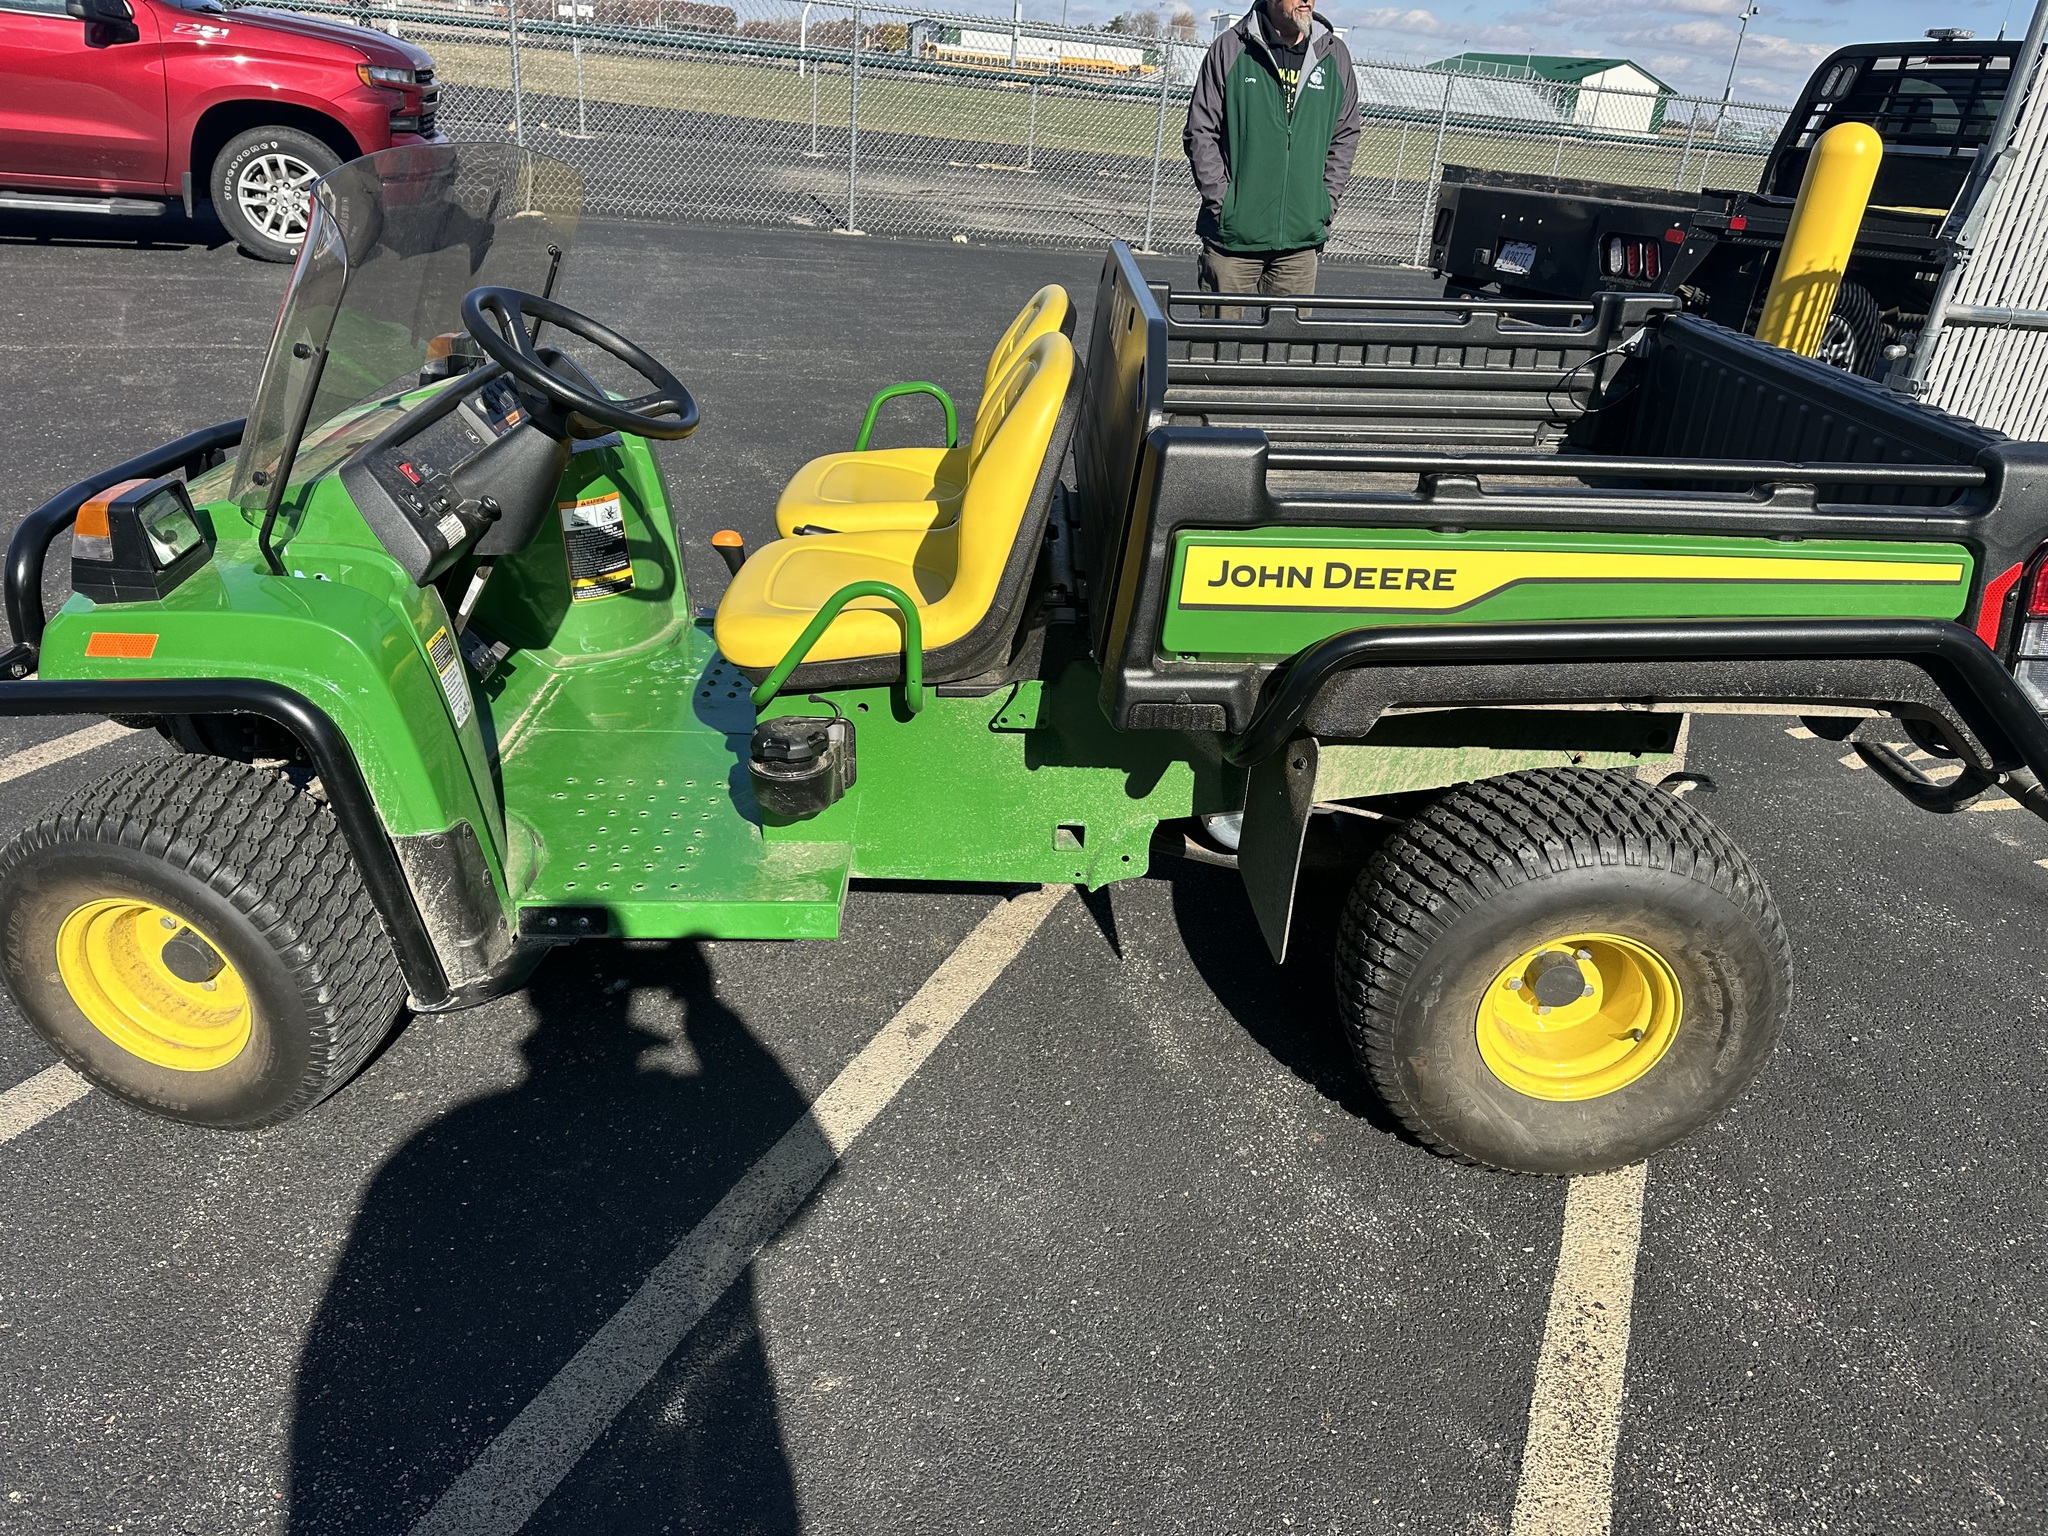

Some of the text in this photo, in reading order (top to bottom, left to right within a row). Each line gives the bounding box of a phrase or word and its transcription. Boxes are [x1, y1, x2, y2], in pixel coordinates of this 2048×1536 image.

[1207, 560, 1457, 591] JOHN DEERE
[1433, 1017, 1477, 1117] WANDA
